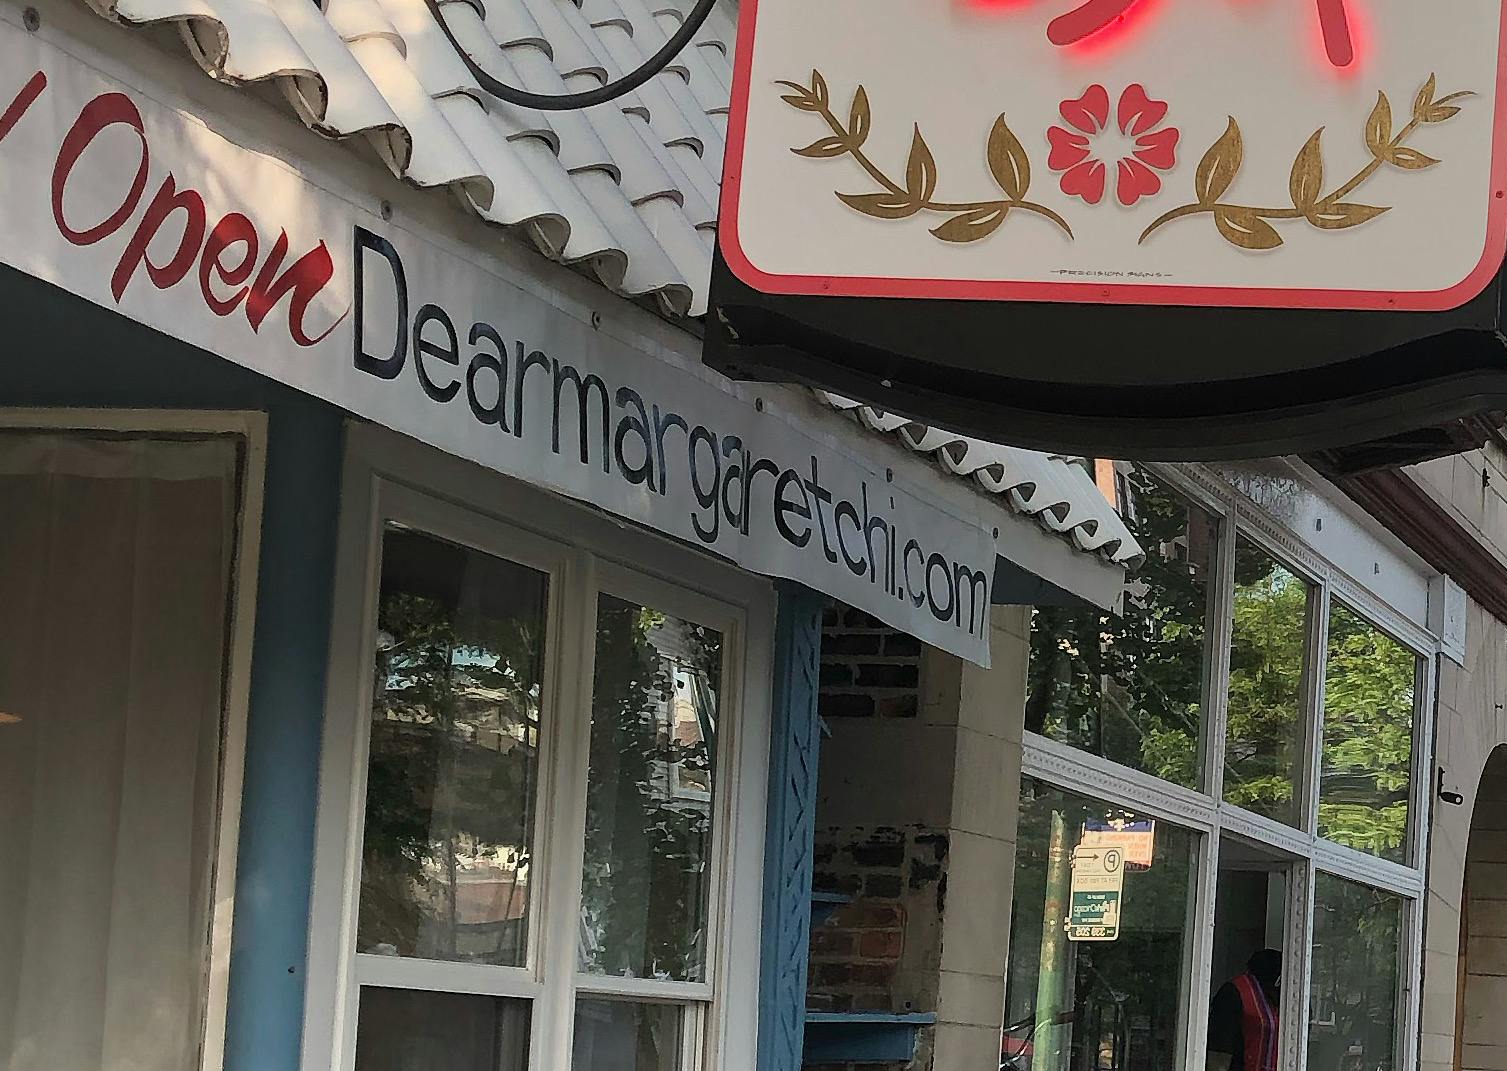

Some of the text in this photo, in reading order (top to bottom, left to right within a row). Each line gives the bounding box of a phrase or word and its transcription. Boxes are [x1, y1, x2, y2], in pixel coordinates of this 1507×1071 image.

[51, 91, 349, 347] Open
[1059, 269, 1124, 277] PRECISION
[353, 224, 987, 641] Dearmargaretchi.com
